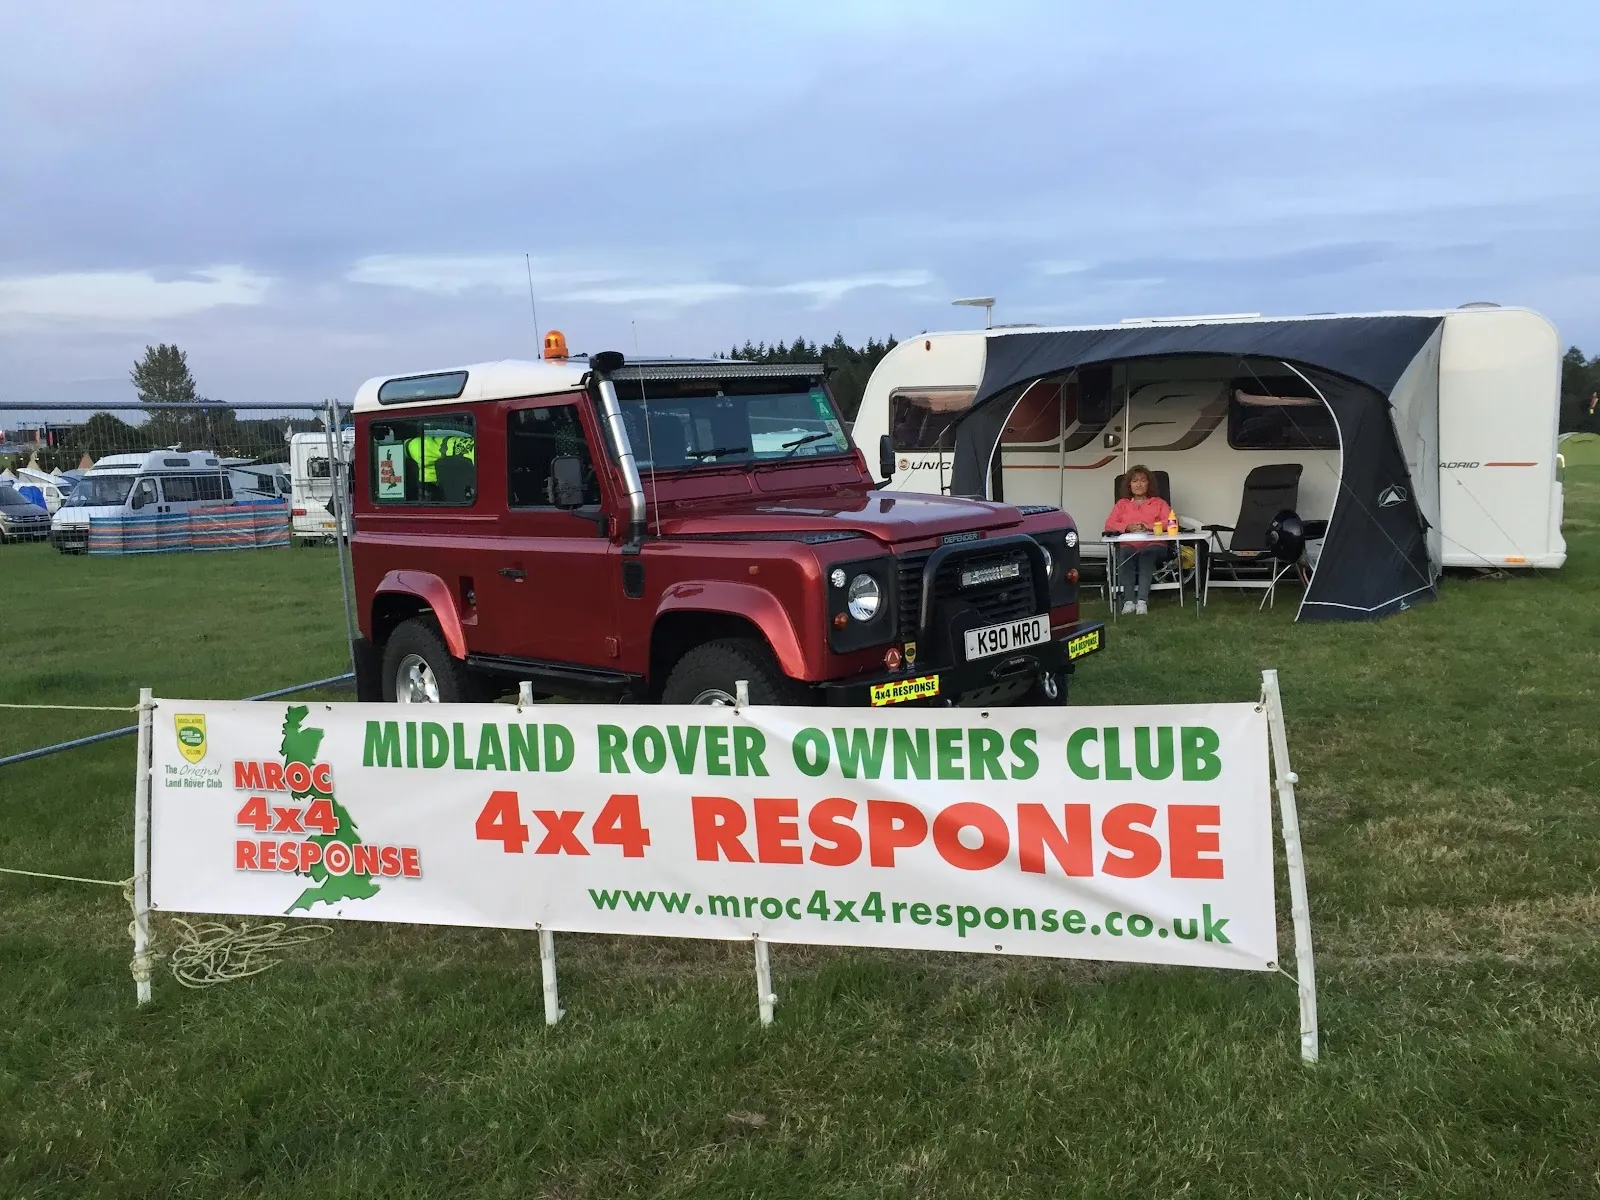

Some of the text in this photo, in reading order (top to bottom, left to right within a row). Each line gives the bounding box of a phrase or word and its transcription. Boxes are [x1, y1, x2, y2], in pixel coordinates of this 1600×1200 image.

[911, 461, 953, 470] UNIC
[944, 533, 978, 544] DEFENDER
[977, 620, 1040, 655] K90 MRO
[1078, 636, 1097, 650] RESPONSE
[875, 681, 936, 700] 4x4 RESPONSE
[362, 720, 1222, 782] MIDLAND ROVER OWNERS CLUB
[165, 763, 222, 780] The Original
[165, 778, 223, 788] Land Rover Club
[233, 760, 333, 794] MROC
[235, 796, 340, 836] 4x4
[475, 790, 1225, 880] 4x4 RESPONSE
[235, 840, 422, 878] RESPONSE
[588, 888, 1234, 945] www.mroc4x4response.co.uk
